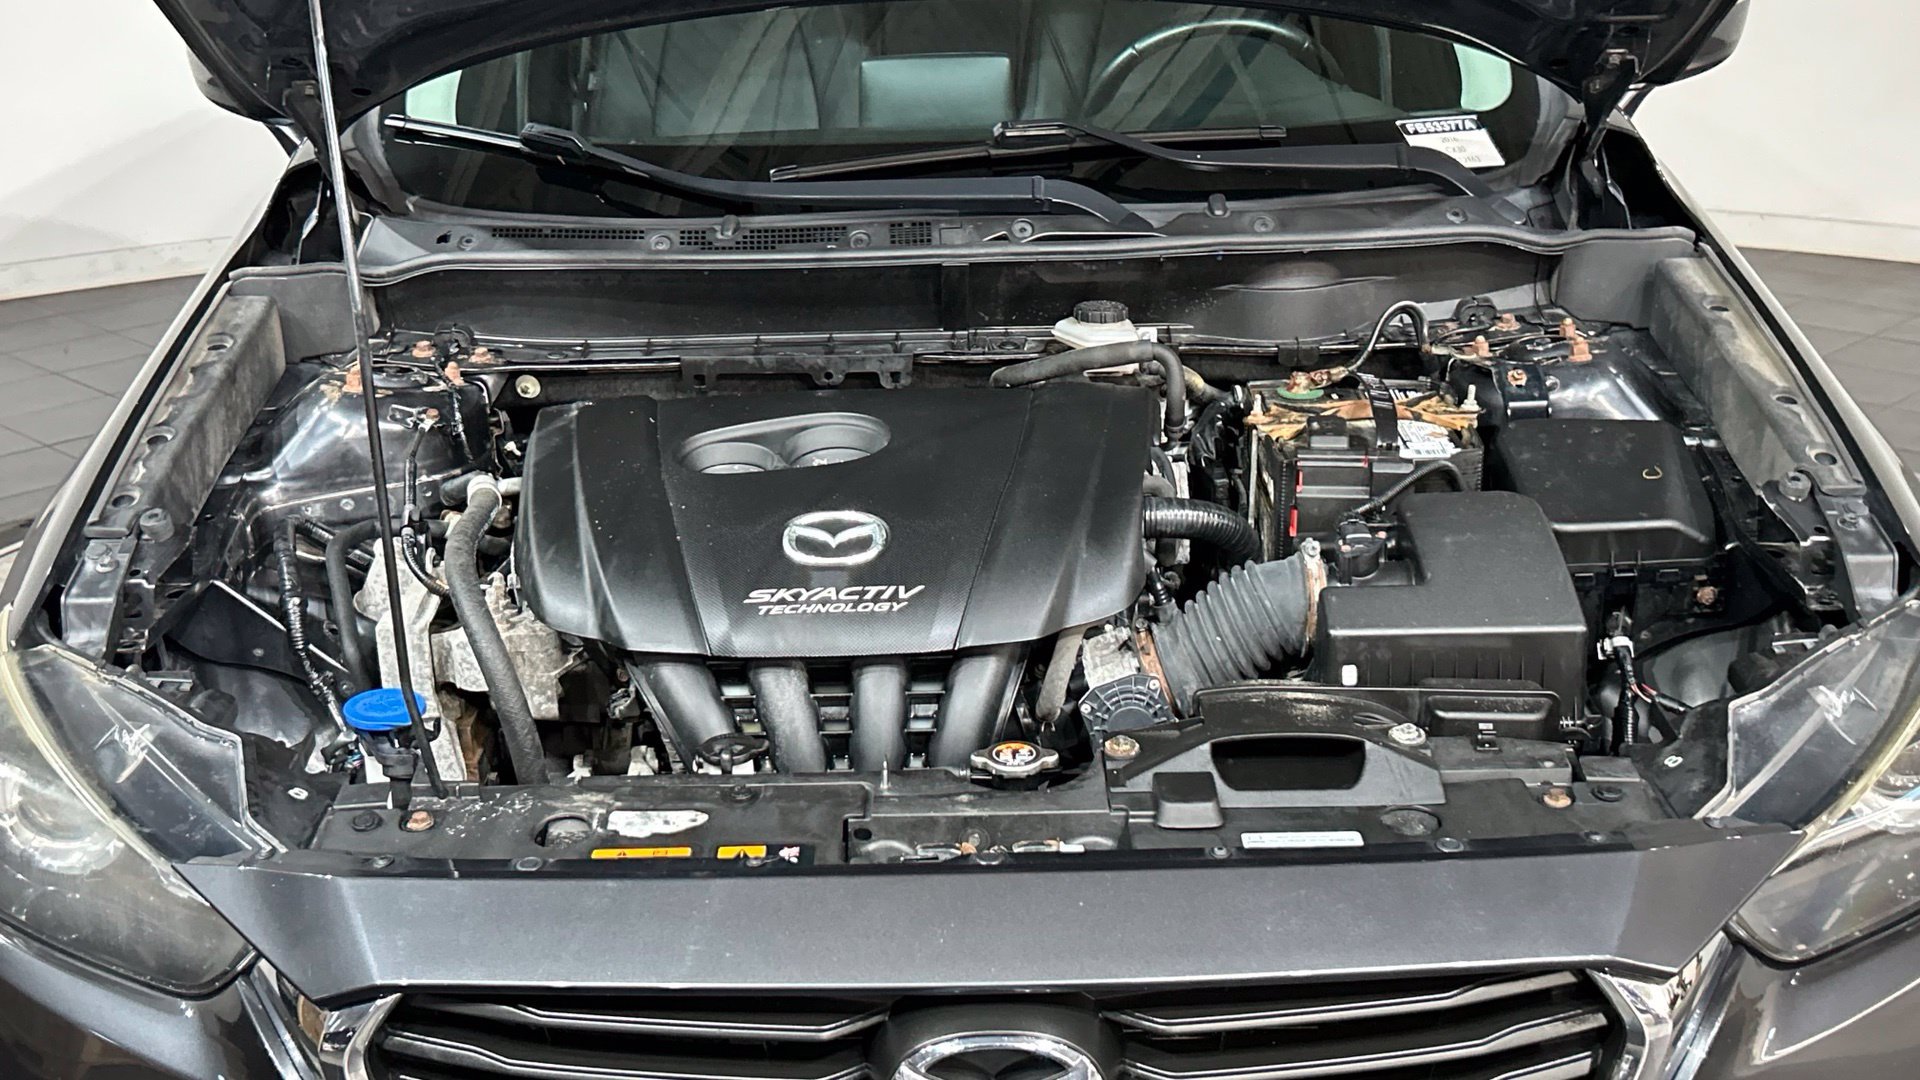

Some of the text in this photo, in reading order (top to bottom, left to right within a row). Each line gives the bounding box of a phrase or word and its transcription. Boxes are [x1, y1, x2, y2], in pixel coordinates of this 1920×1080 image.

[1405, 119, 1477, 134] FB53377A
[743, 585, 925, 604] SKYACTIV
[757, 602, 908, 616] TECHNOLOGY
